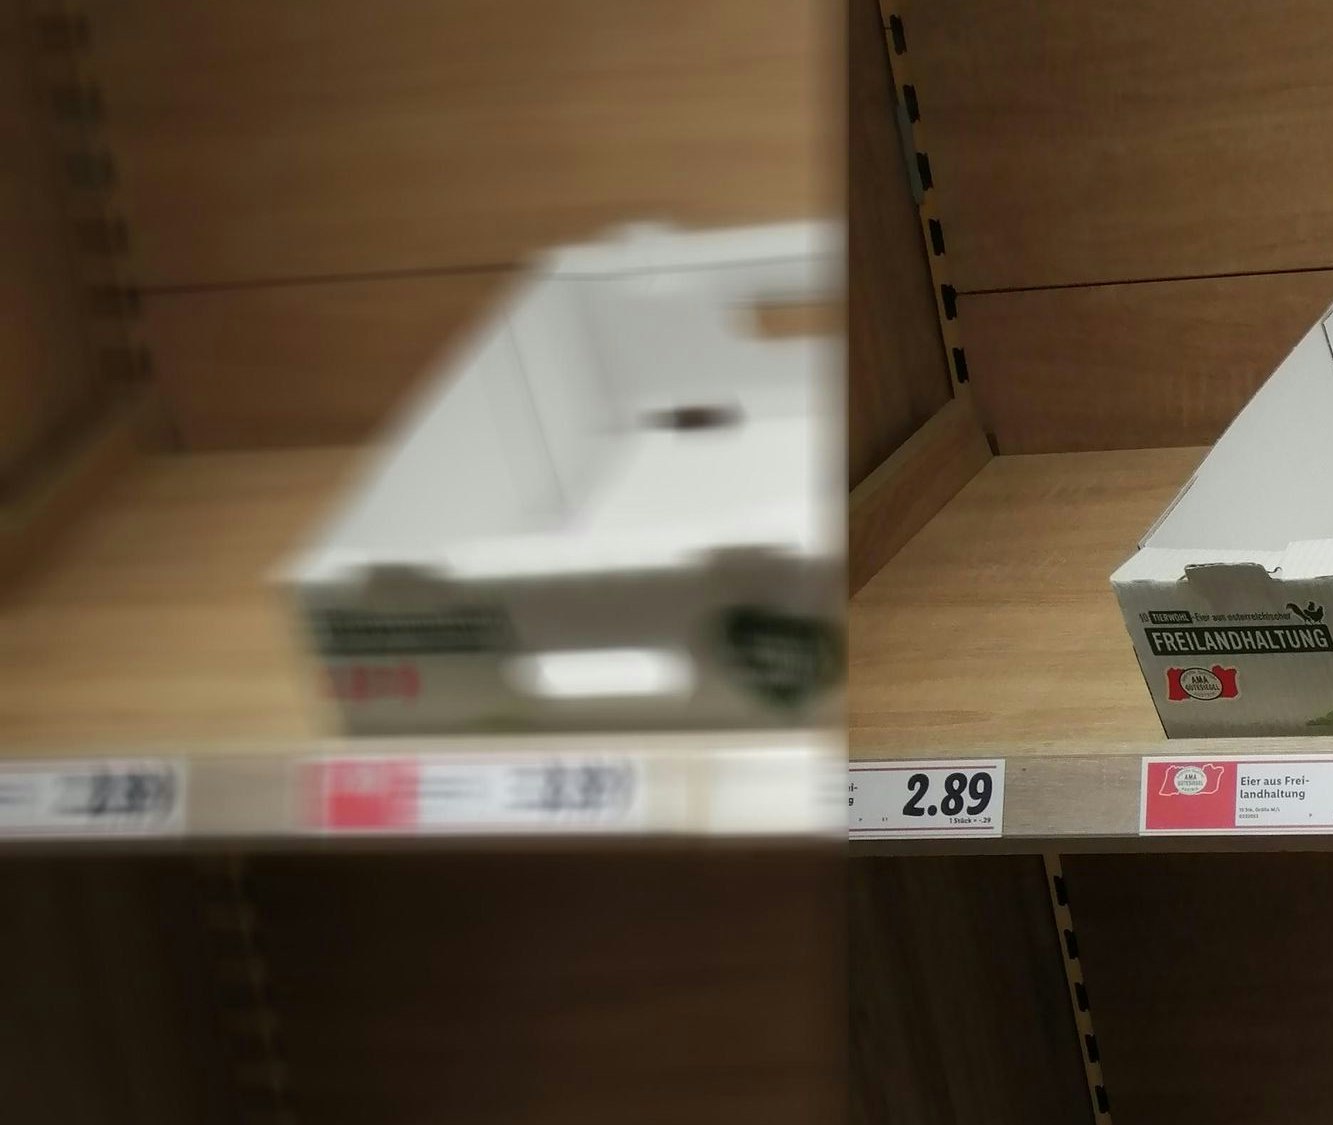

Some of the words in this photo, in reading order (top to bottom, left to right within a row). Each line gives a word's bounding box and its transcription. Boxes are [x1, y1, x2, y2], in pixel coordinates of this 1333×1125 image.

[1152, 628, 1328, 651] FREILANDHALTUNG
[1240, 776, 1262, 786] Eier
[1263, 777, 1282, 786] aus
[1284, 775, 1310, 786] Frei-
[902, 772, 993, 816] 2.89
[1240, 789, 1306, 800] landhaltung
